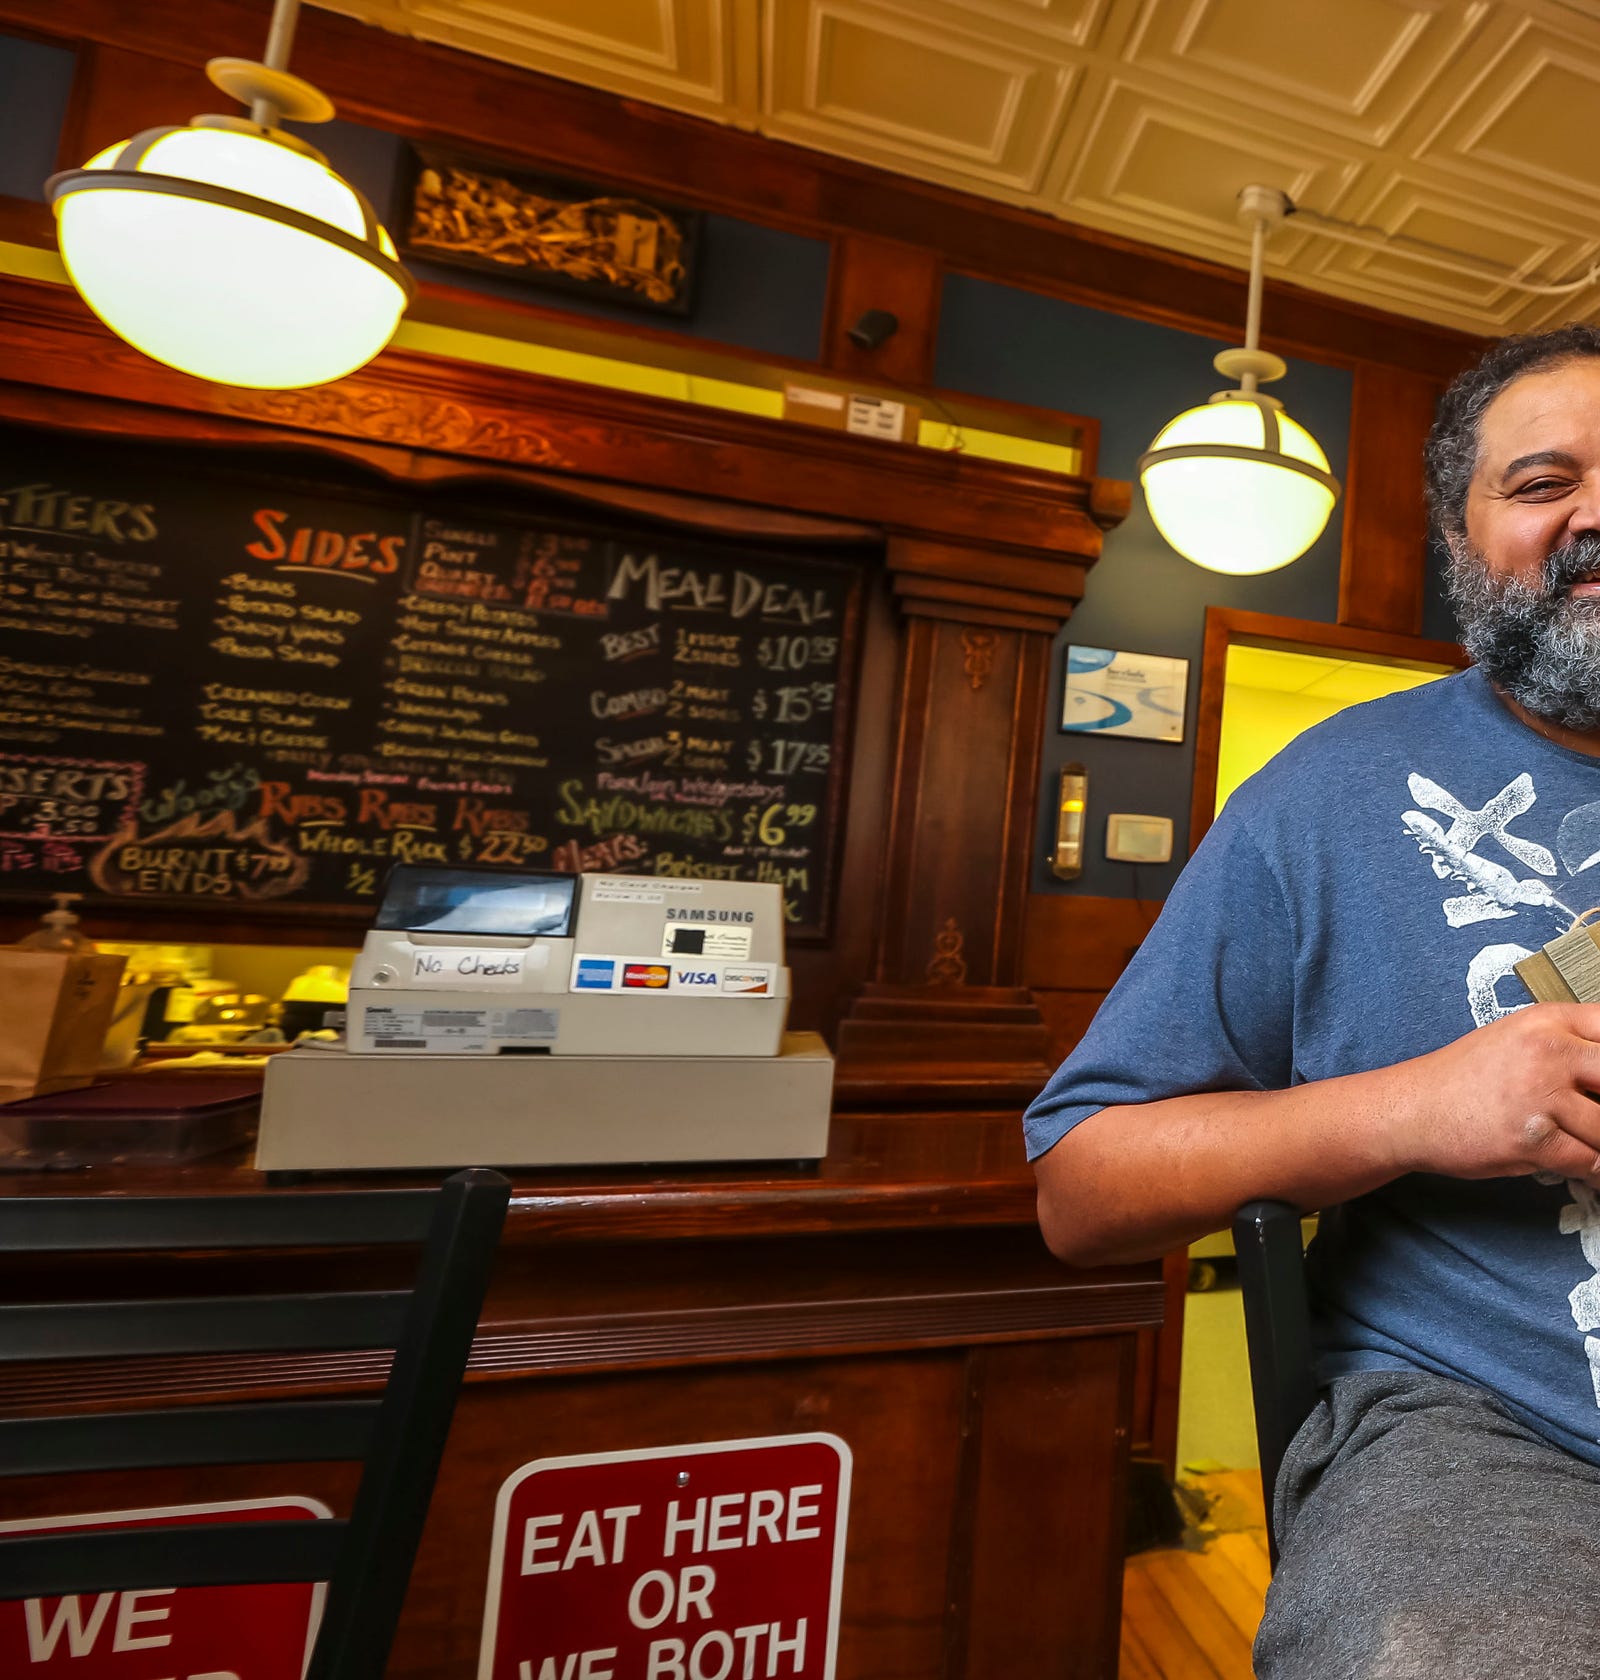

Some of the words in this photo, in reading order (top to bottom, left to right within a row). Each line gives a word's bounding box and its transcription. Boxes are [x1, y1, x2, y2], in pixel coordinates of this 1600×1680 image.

[245, 508, 405, 574] SIDES
[607, 553, 728, 612] MEAL
[728, 569, 834, 626] DEAL
[666, 907, 755, 924] SAMSUNG
[415, 955, 444, 976] No
[457, 954, 520, 976] Checks
[677, 971, 718, 985] VISA
[520, 1504, 642, 1577] EAT
[662, 1483, 823, 1558] HERE
[24, 1587, 179, 1664] WE
[627, 1564, 717, 1631] OR
[646, 1617, 809, 1680] BOTH
